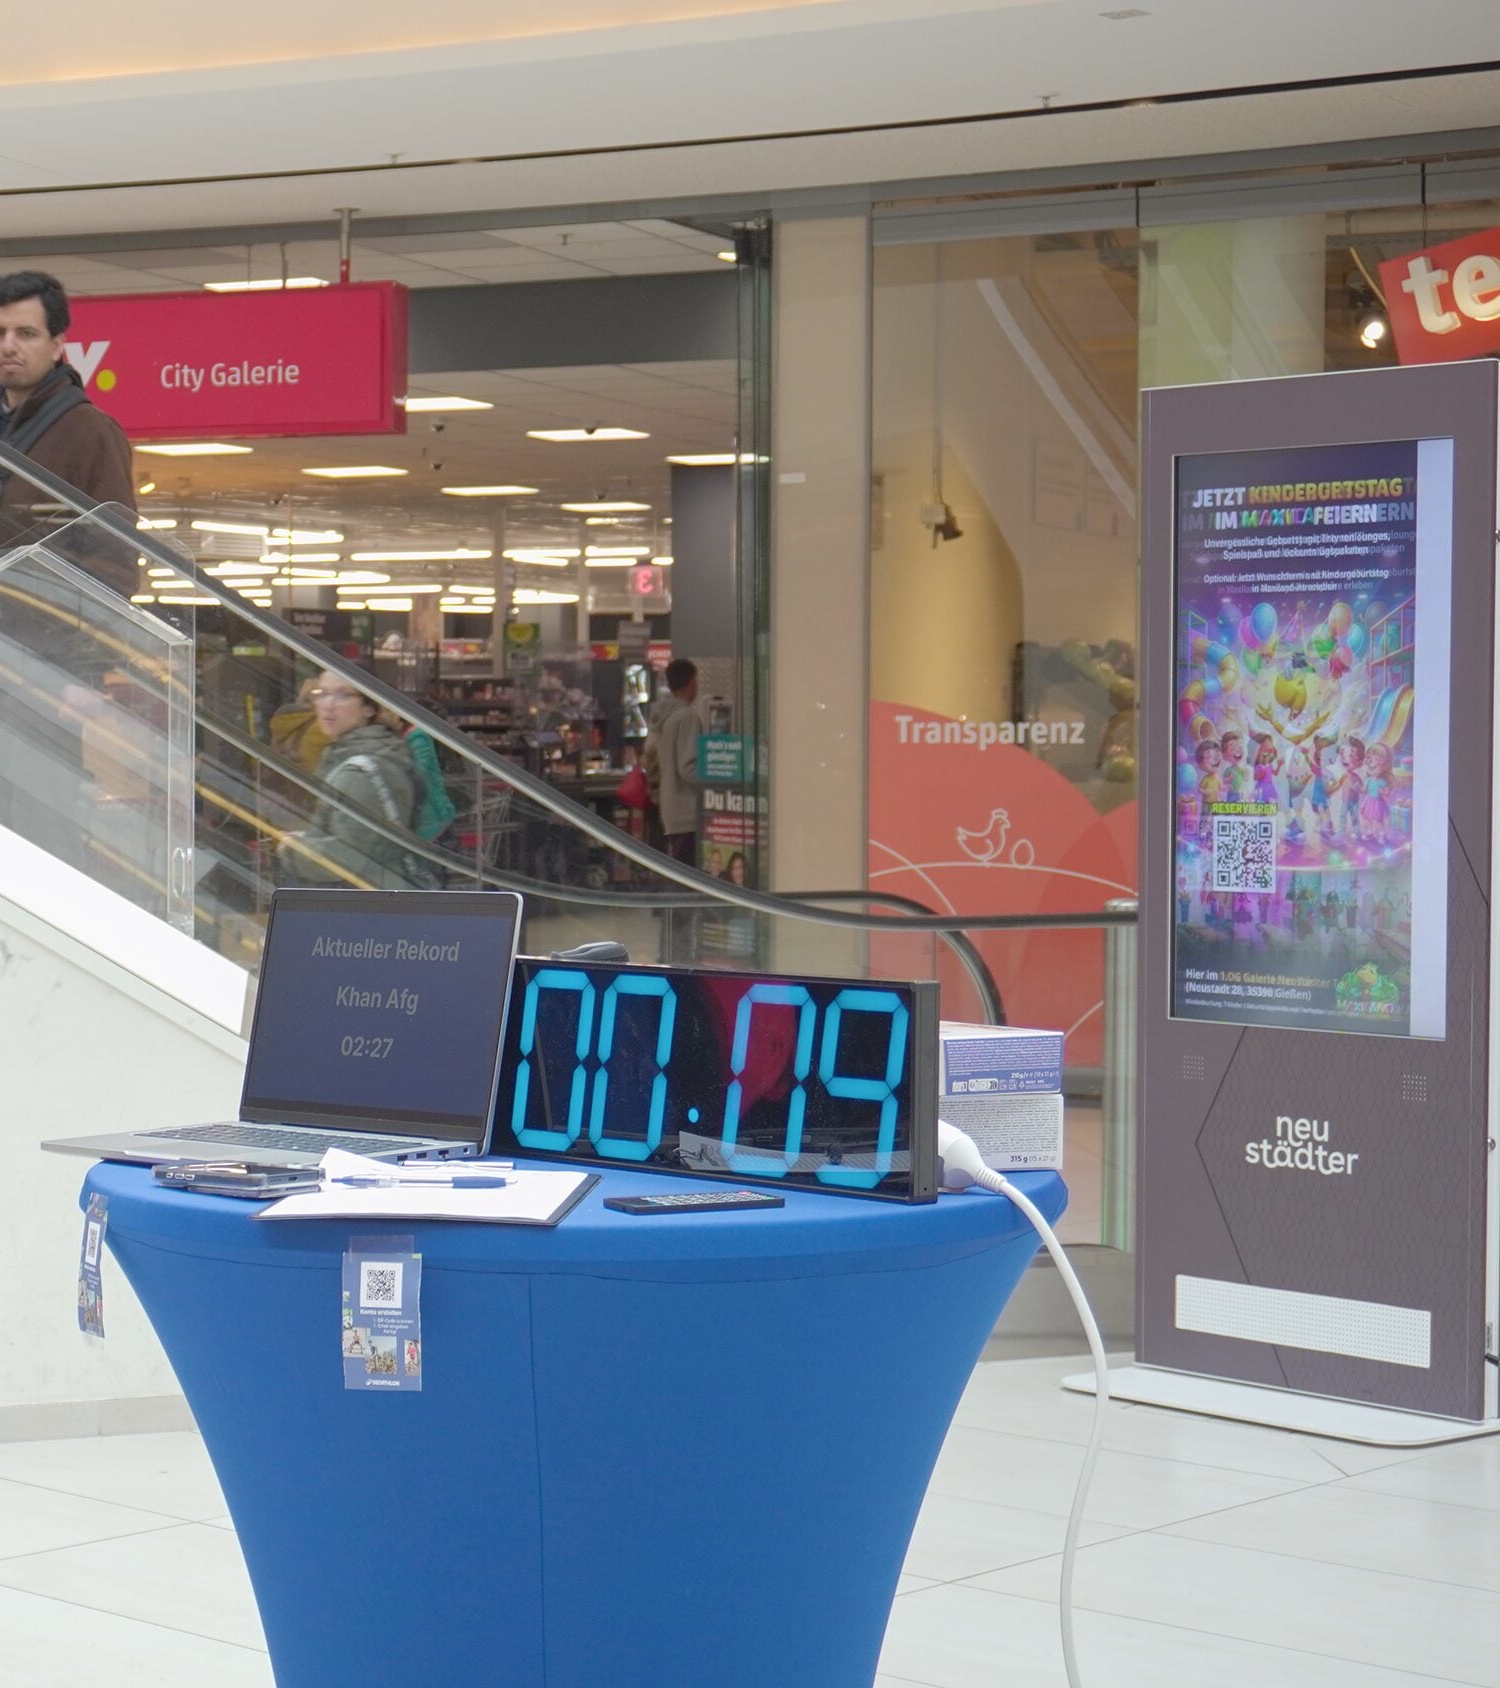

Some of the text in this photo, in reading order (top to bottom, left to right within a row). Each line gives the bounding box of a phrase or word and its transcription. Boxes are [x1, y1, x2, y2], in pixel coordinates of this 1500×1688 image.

[160, 358, 300, 392] City Galerie
[895, 715, 1085, 751] Transparenz
[312, 936, 460, 962] Aktueller Rekord
[336, 985, 419, 1016] Khan Afg
[341, 1035, 394, 1058] 02:27
[1276, 1115, 1329, 1147] neu
[1245, 1138, 1359, 1175] städter
